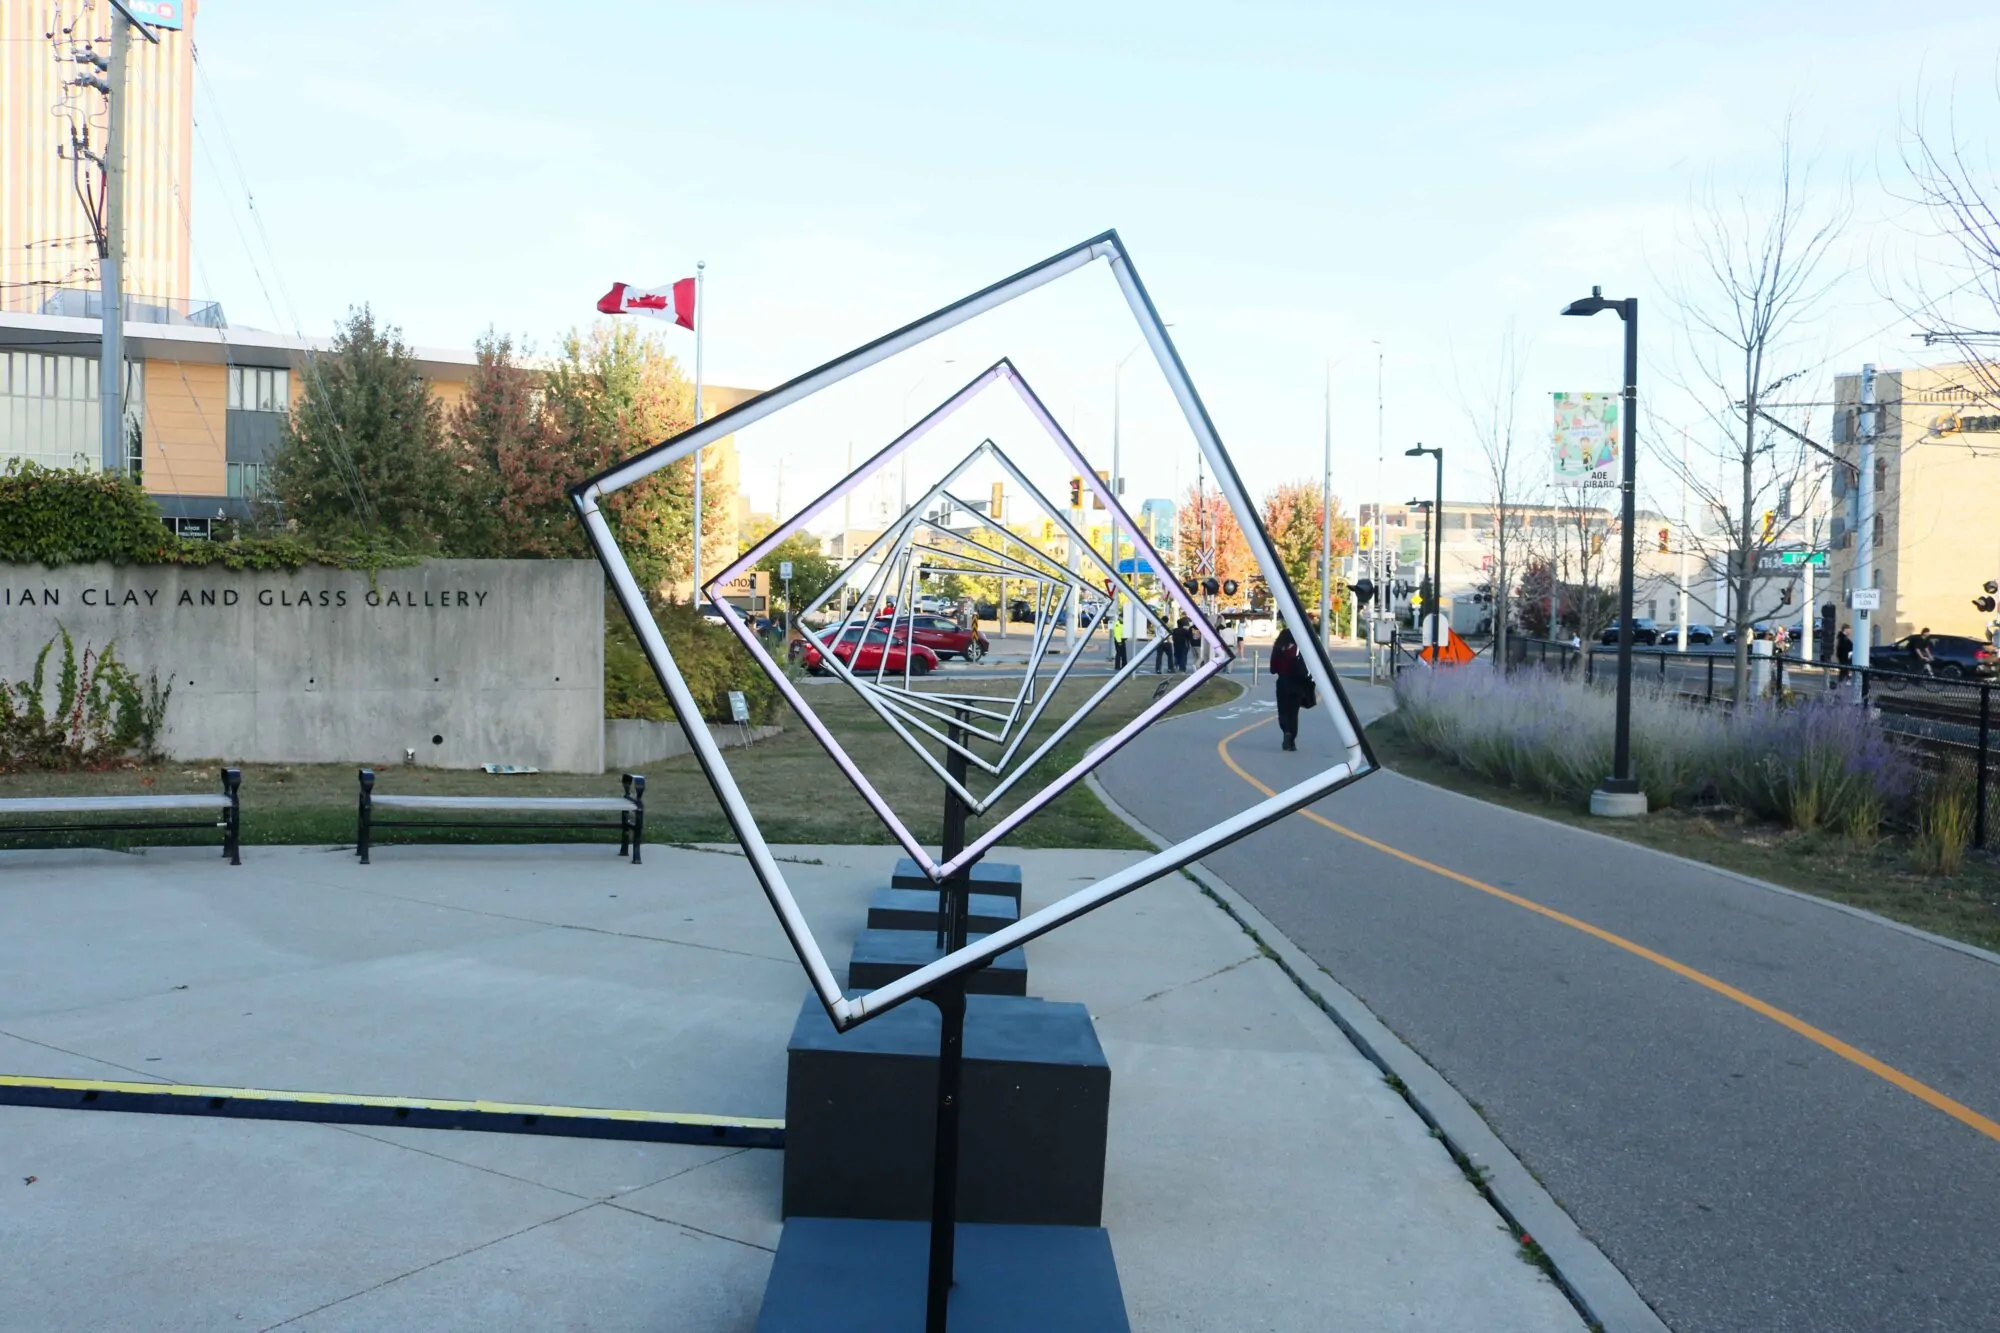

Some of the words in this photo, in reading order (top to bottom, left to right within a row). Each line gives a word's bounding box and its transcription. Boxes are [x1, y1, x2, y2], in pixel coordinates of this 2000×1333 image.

[6, 588, 59, 606] IAN
[82, 588, 159, 606] CLAY
[178, 589, 239, 606] AND
[258, 589, 347, 607] GLASS
[365, 590, 488, 607] GALLERY
